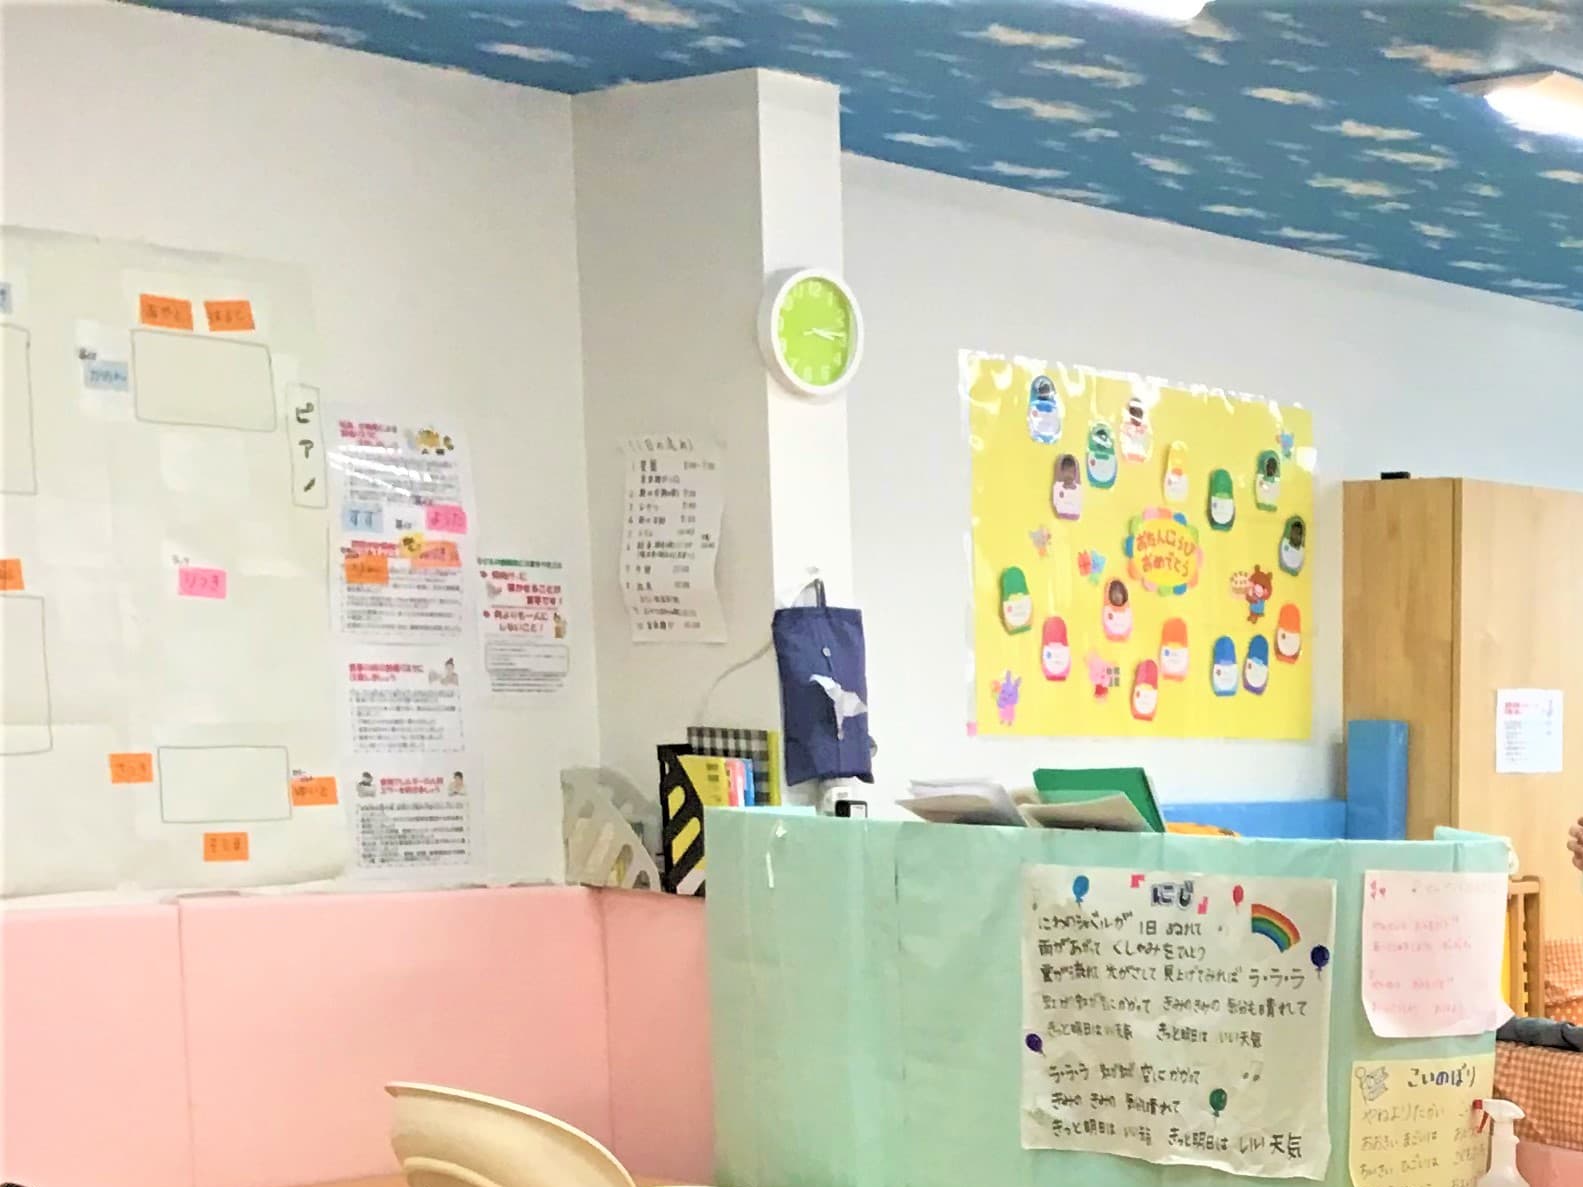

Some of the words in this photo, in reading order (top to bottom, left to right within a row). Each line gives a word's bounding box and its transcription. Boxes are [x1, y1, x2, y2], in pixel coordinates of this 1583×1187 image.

[1141, 552, 1190, 578] おめでとう
[1151, 879, 1194, 909] にじ
[1407, 1063, 1476, 1088] こいのぼり
